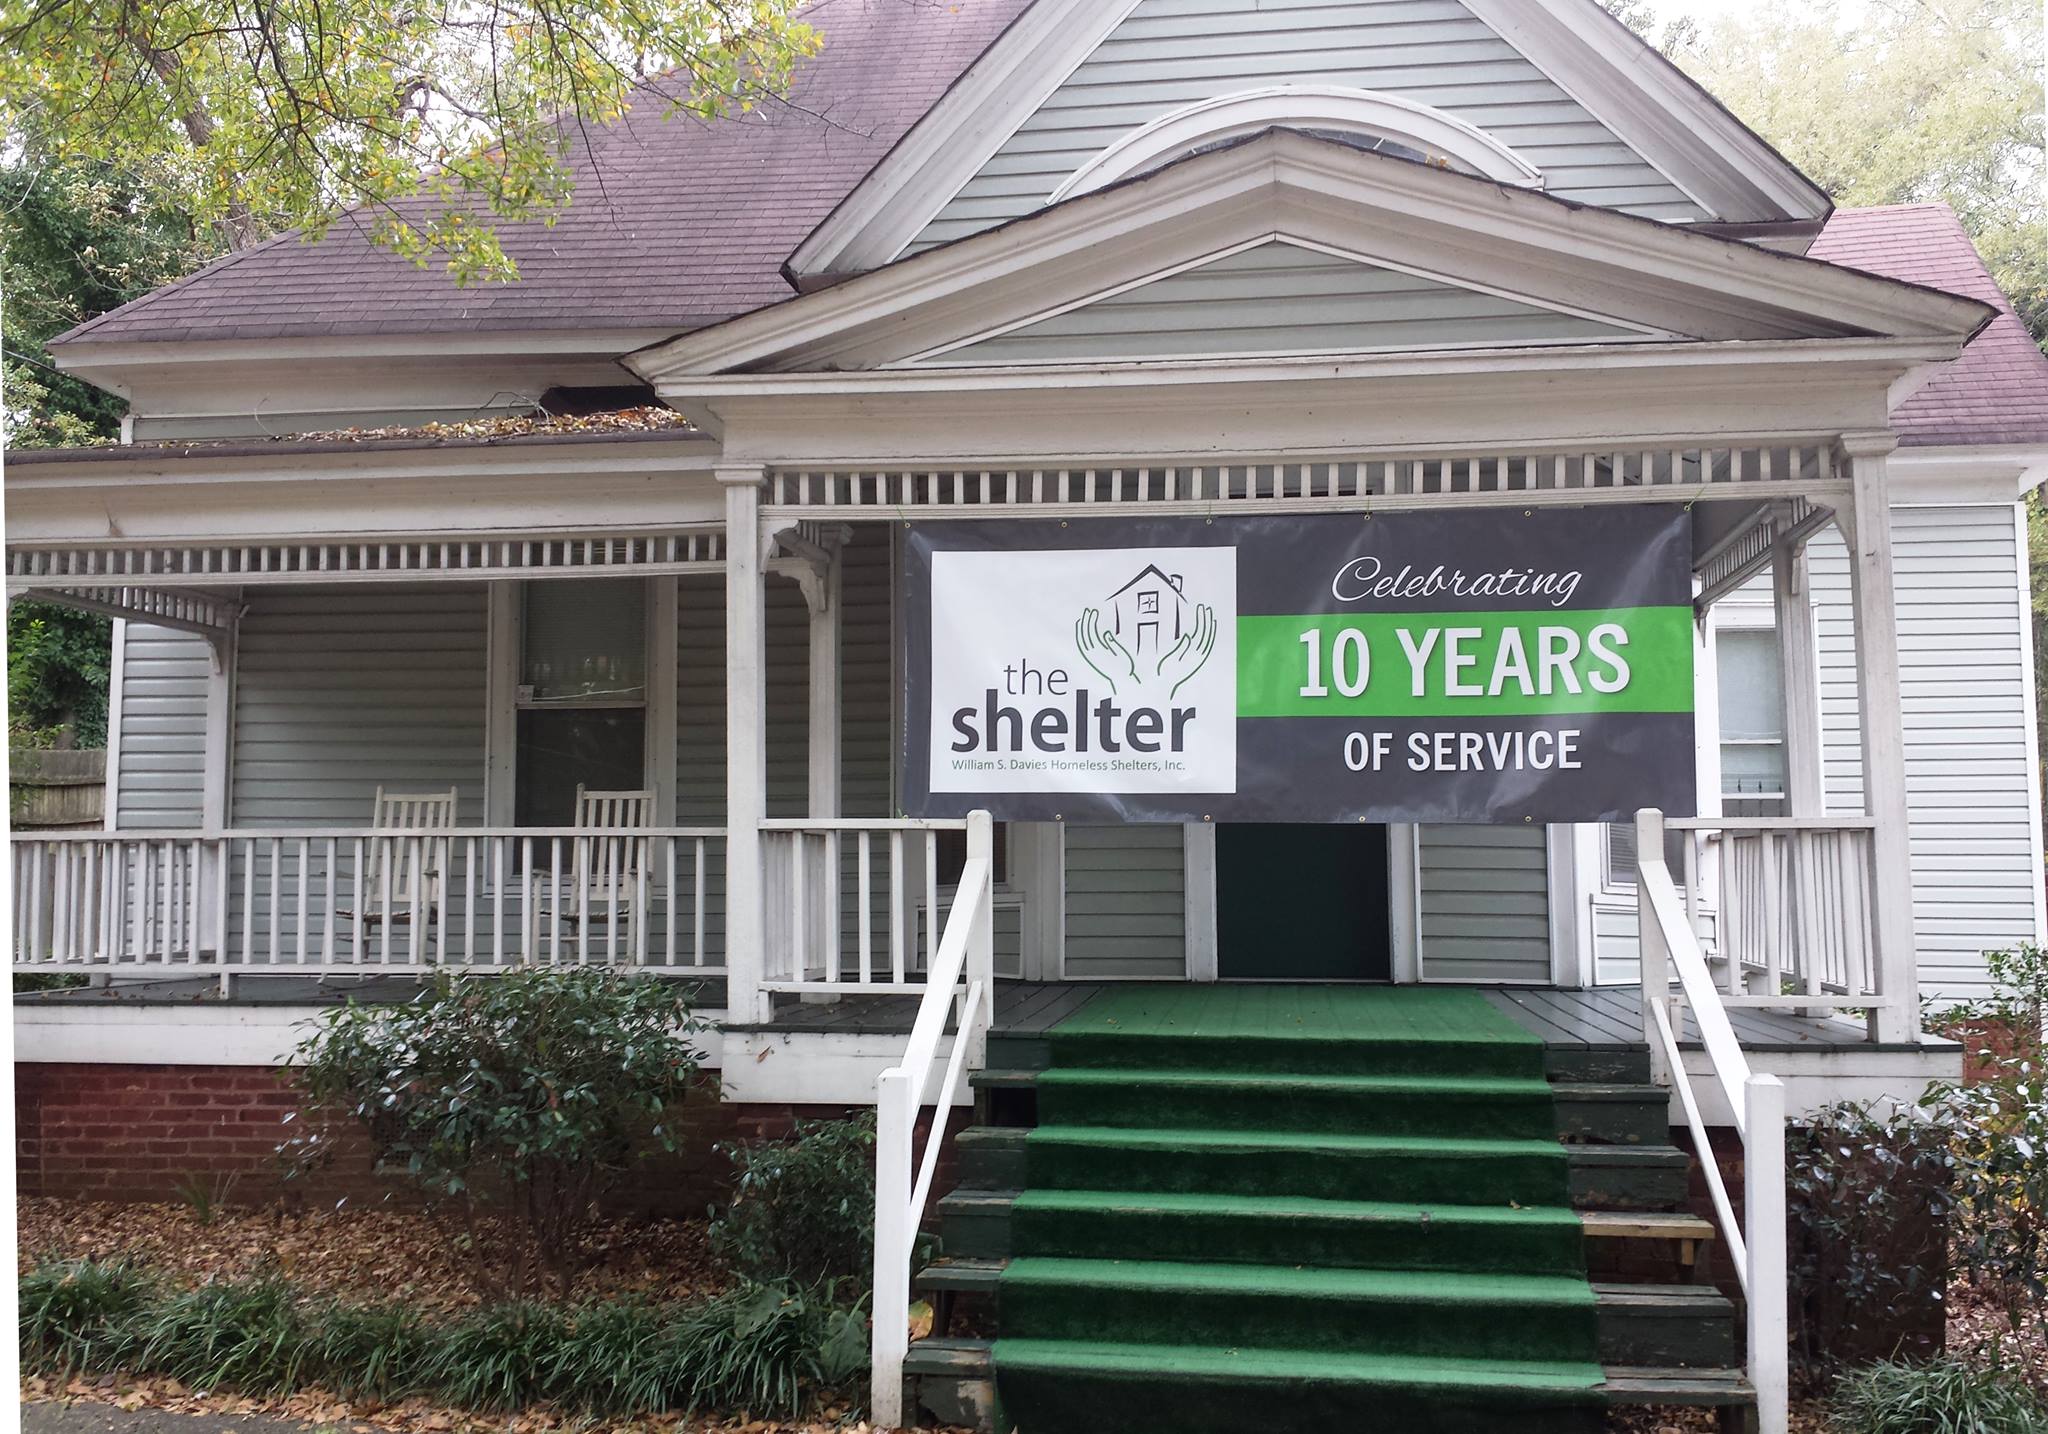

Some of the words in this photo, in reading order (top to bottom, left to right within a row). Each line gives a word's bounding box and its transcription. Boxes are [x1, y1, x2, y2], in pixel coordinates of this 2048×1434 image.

[1332, 556, 1582, 606] Celebrating
[1003, 658, 1069, 695] the
[1299, 628, 1371, 697] 10
[1395, 623, 1631, 697] YEARS
[951, 688, 1196, 753] shelter
[951, 759, 995, 770] William
[997, 760, 1007, 770] S.
[1010, 759, 1047, 770] Davies
[1051, 760, 1108, 771] Homeless
[1111, 760, 1161, 772] Shelters,
[1165, 760, 1186, 770] Inc.
[1344, 732, 1393, 771] OF
[1407, 730, 1582, 771] SERVICE
